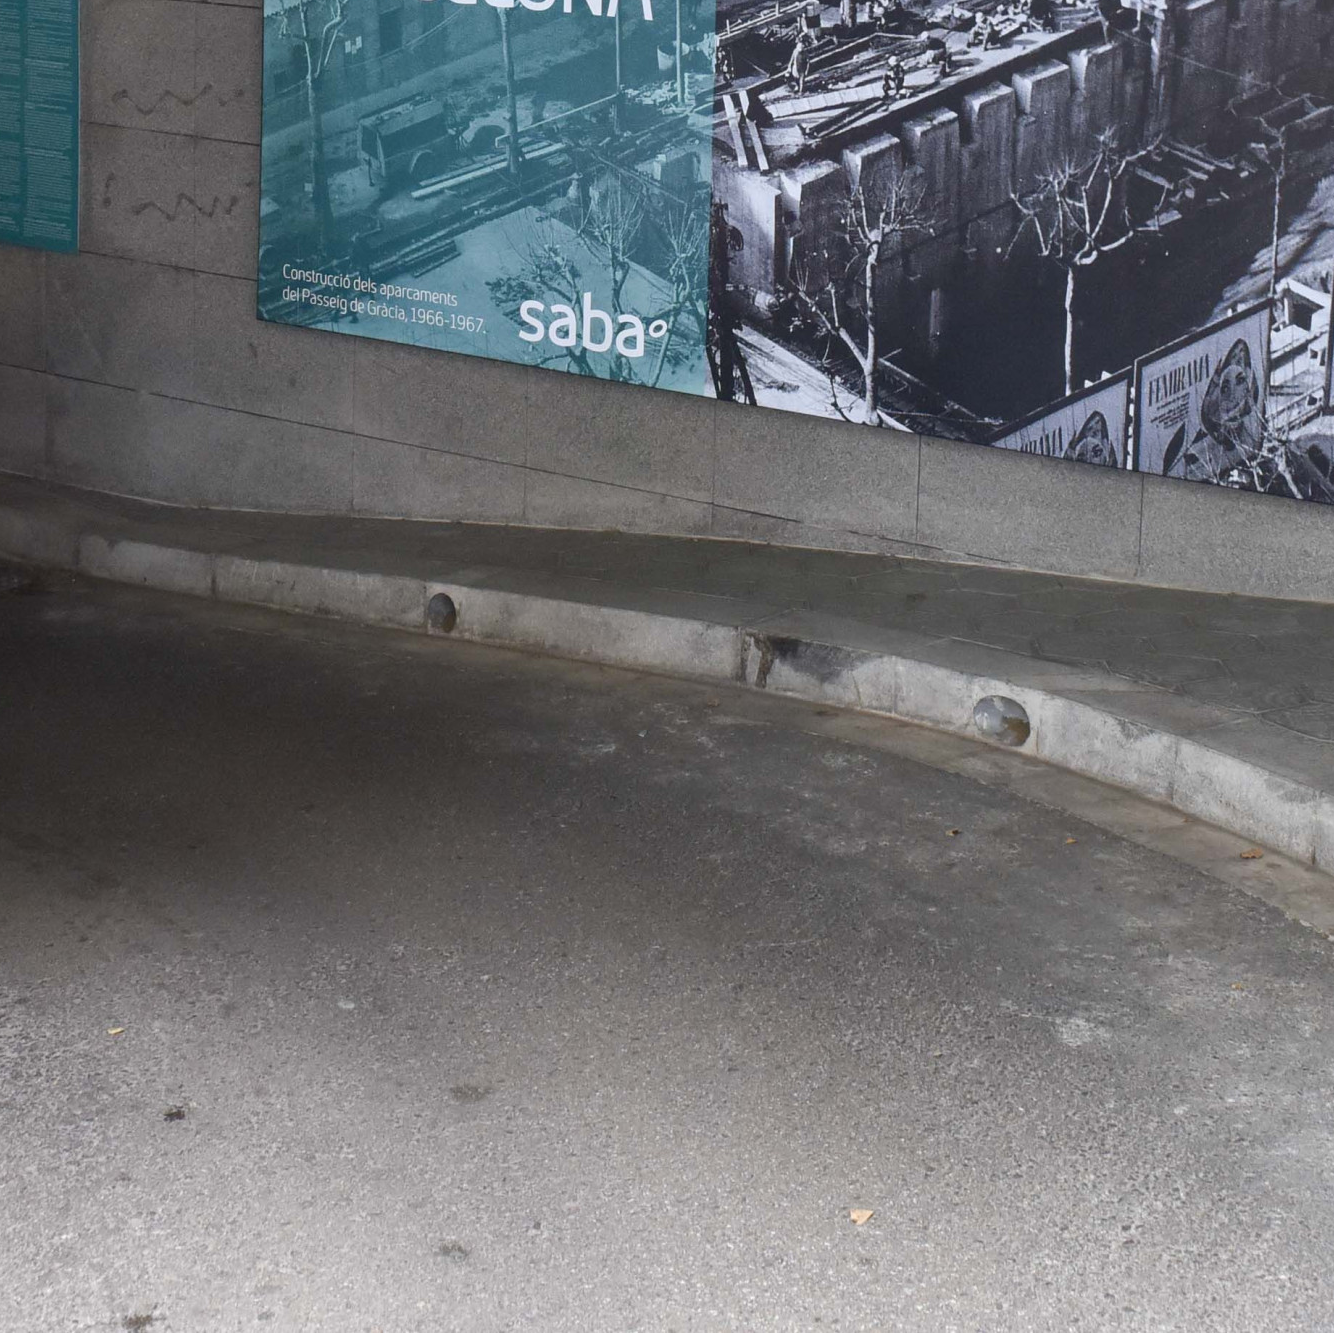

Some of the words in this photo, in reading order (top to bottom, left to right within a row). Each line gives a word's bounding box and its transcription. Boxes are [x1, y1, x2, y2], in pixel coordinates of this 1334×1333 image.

[283, 264, 351, 289] Construcció
[353, 275, 377, 294] dels
[379, 283, 458, 307] aparcaments
[282, 286, 300, 302] del
[302, 288, 348, 315] Passeig
[350, 297, 364, 314] de
[367, 300, 408, 323] Gràcia,
[410, 307, 487, 334] 1966-1967.
